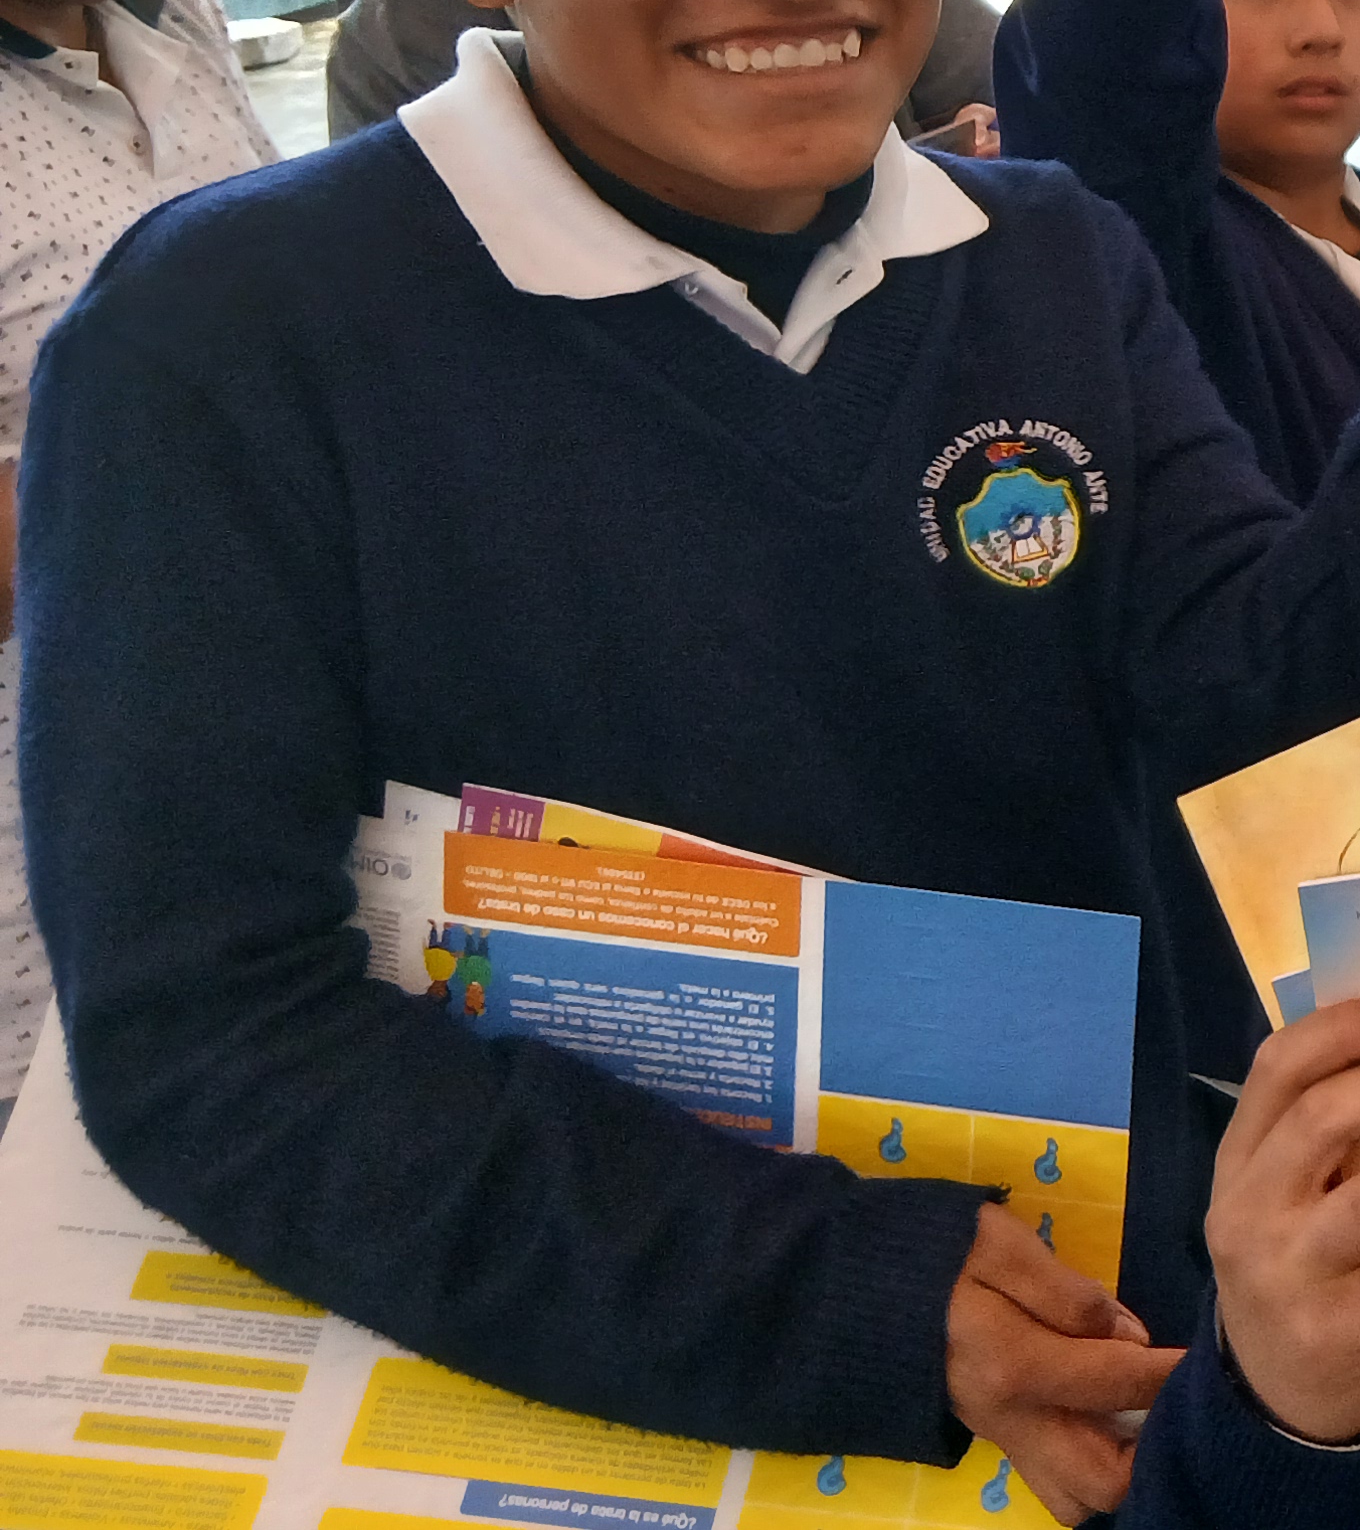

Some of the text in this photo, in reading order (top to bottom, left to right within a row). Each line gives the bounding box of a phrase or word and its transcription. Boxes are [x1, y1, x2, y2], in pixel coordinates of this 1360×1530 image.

[577, 908, 594, 923] un
[732, 927, 767, 944] ¿Qué
[497, 1489, 570, 1514] personas?
[569, 1501, 588, 1516] de
[626, 1509, 640, 1522] la
[660, 1509, 697, 1529] ¿Qué
